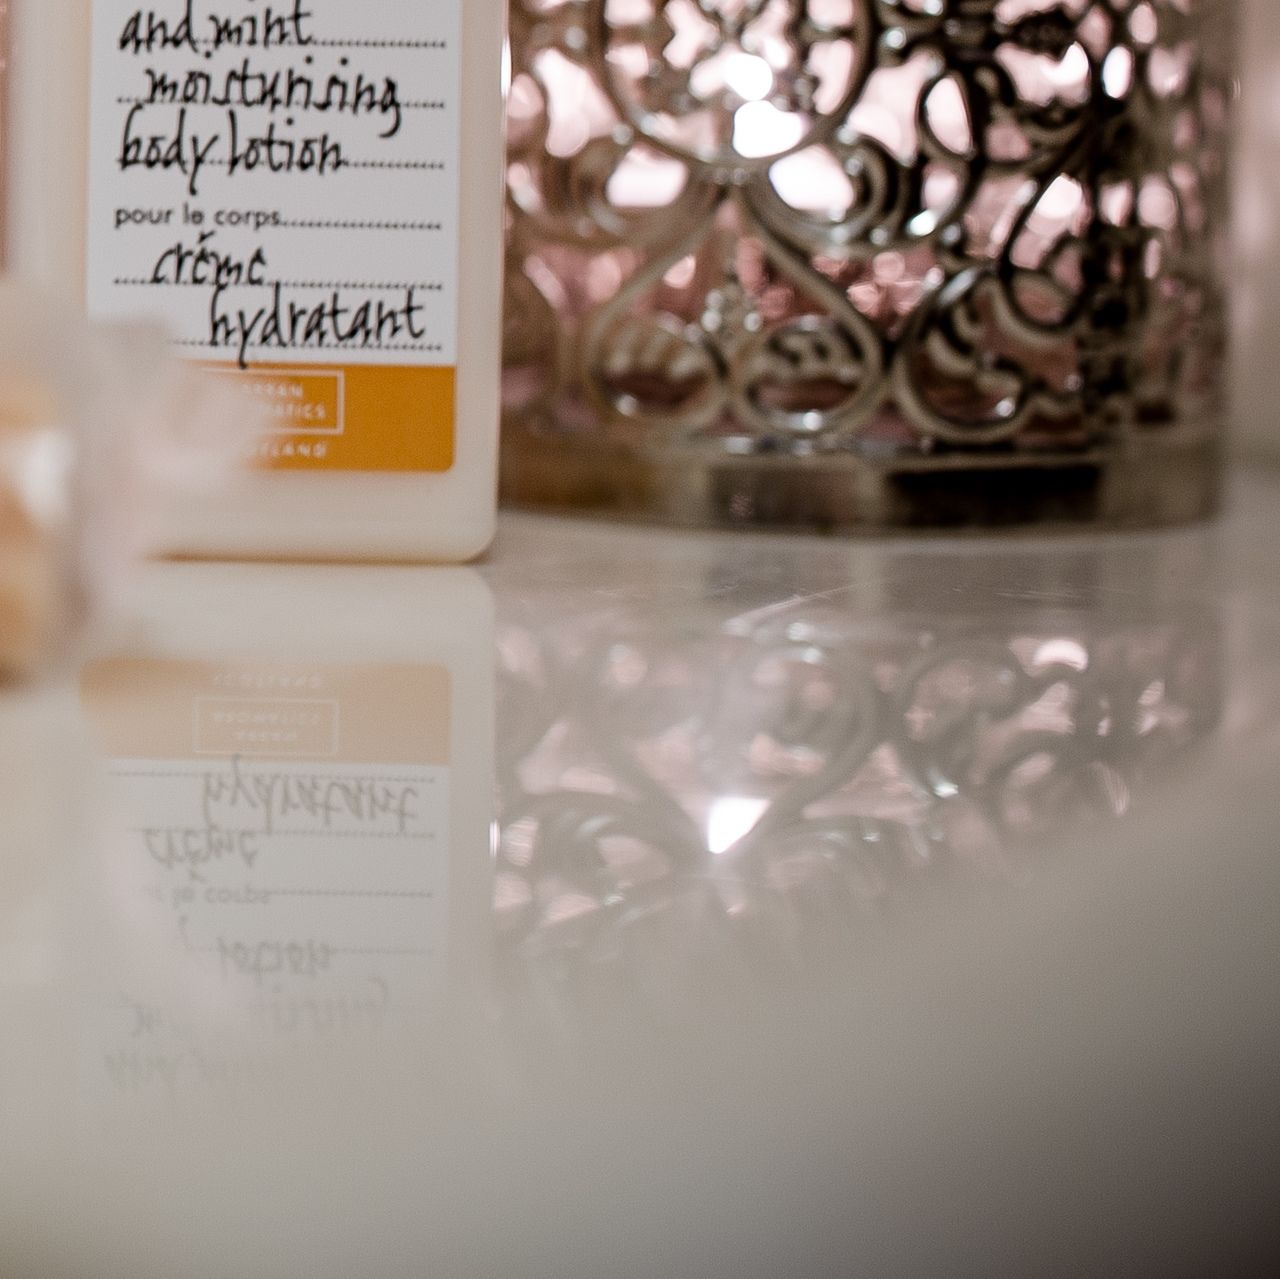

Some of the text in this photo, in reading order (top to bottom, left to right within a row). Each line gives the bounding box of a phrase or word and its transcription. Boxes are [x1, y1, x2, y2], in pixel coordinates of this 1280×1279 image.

[144, 49, 402, 138] moisturising
[120, 102, 347, 196] body lotion
[115, 204, 280, 231] pour le corps
[210, 282, 426, 370] hydratant
